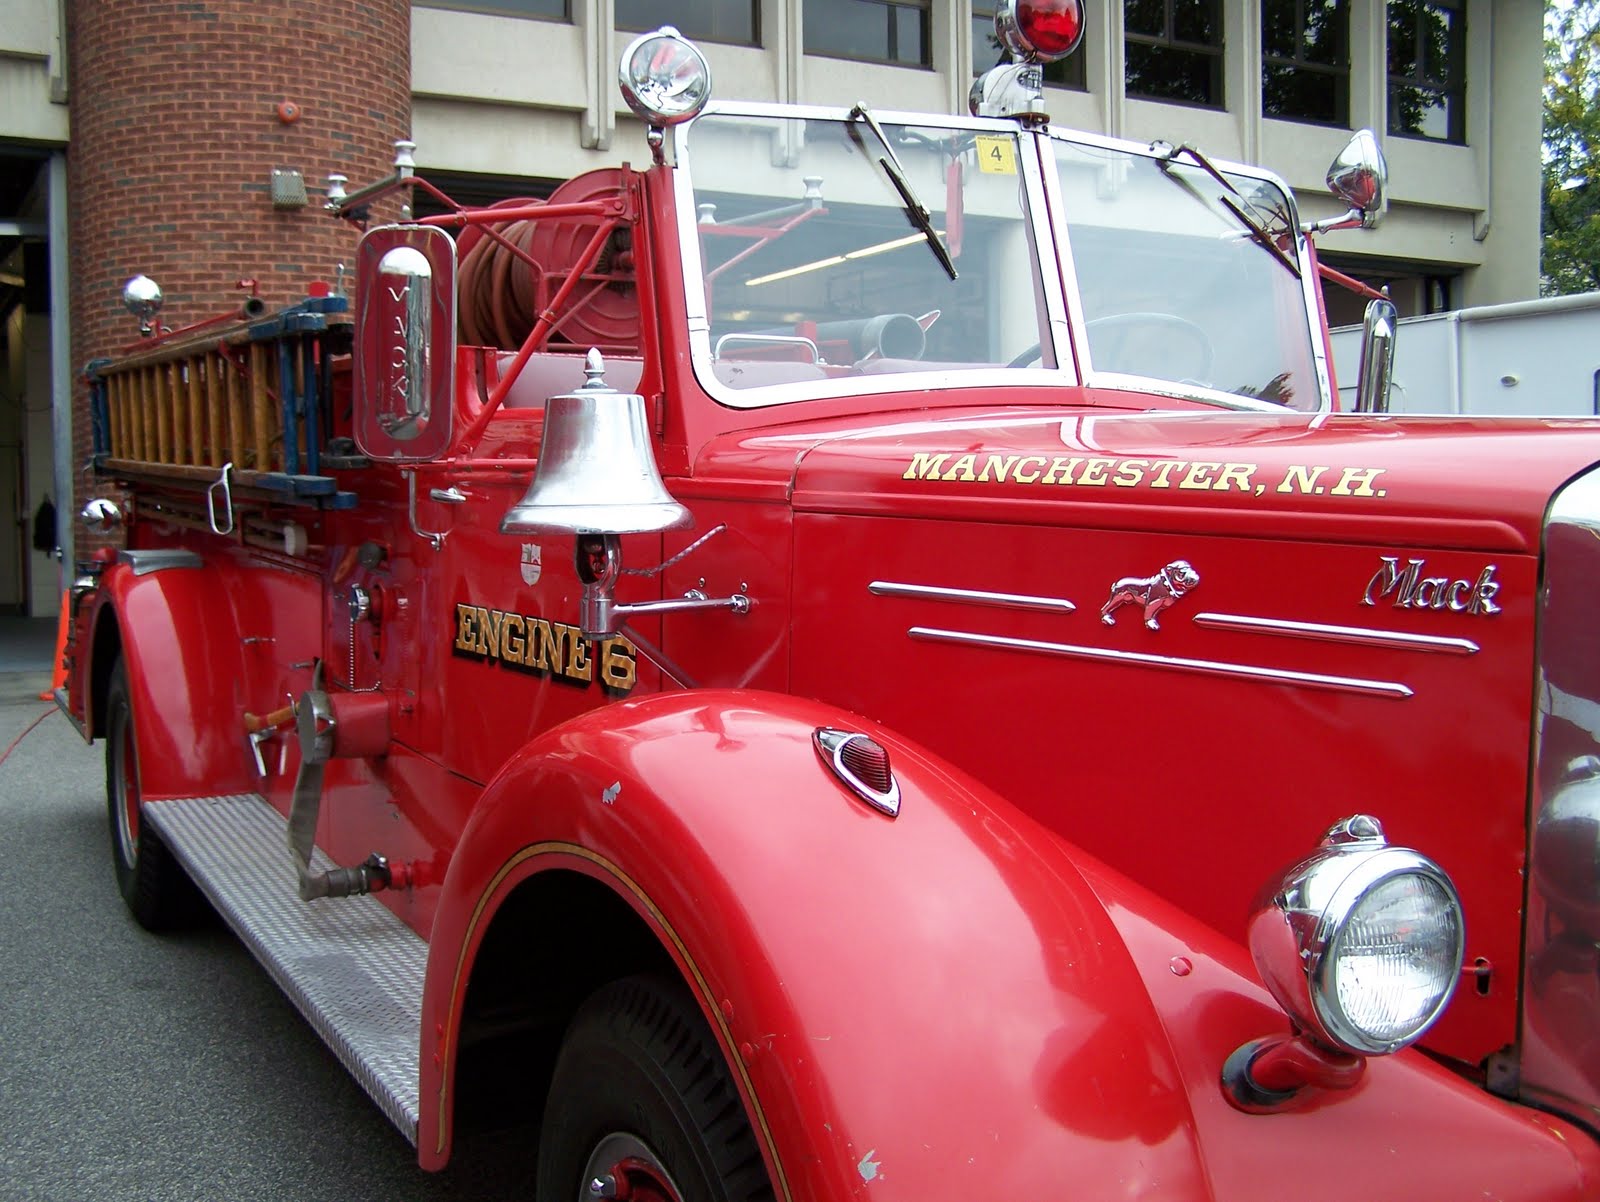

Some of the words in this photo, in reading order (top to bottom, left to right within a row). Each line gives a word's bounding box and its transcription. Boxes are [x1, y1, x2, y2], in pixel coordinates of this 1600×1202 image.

[990, 145, 1003, 162] 4
[902, 452, 1266, 498] MANCHESTER,
[1276, 464, 1388, 498] N.H.
[1358, 556, 1502, 616] Mack
[454, 603, 593, 684] ENGINE
[601, 631, 638, 693] 6
